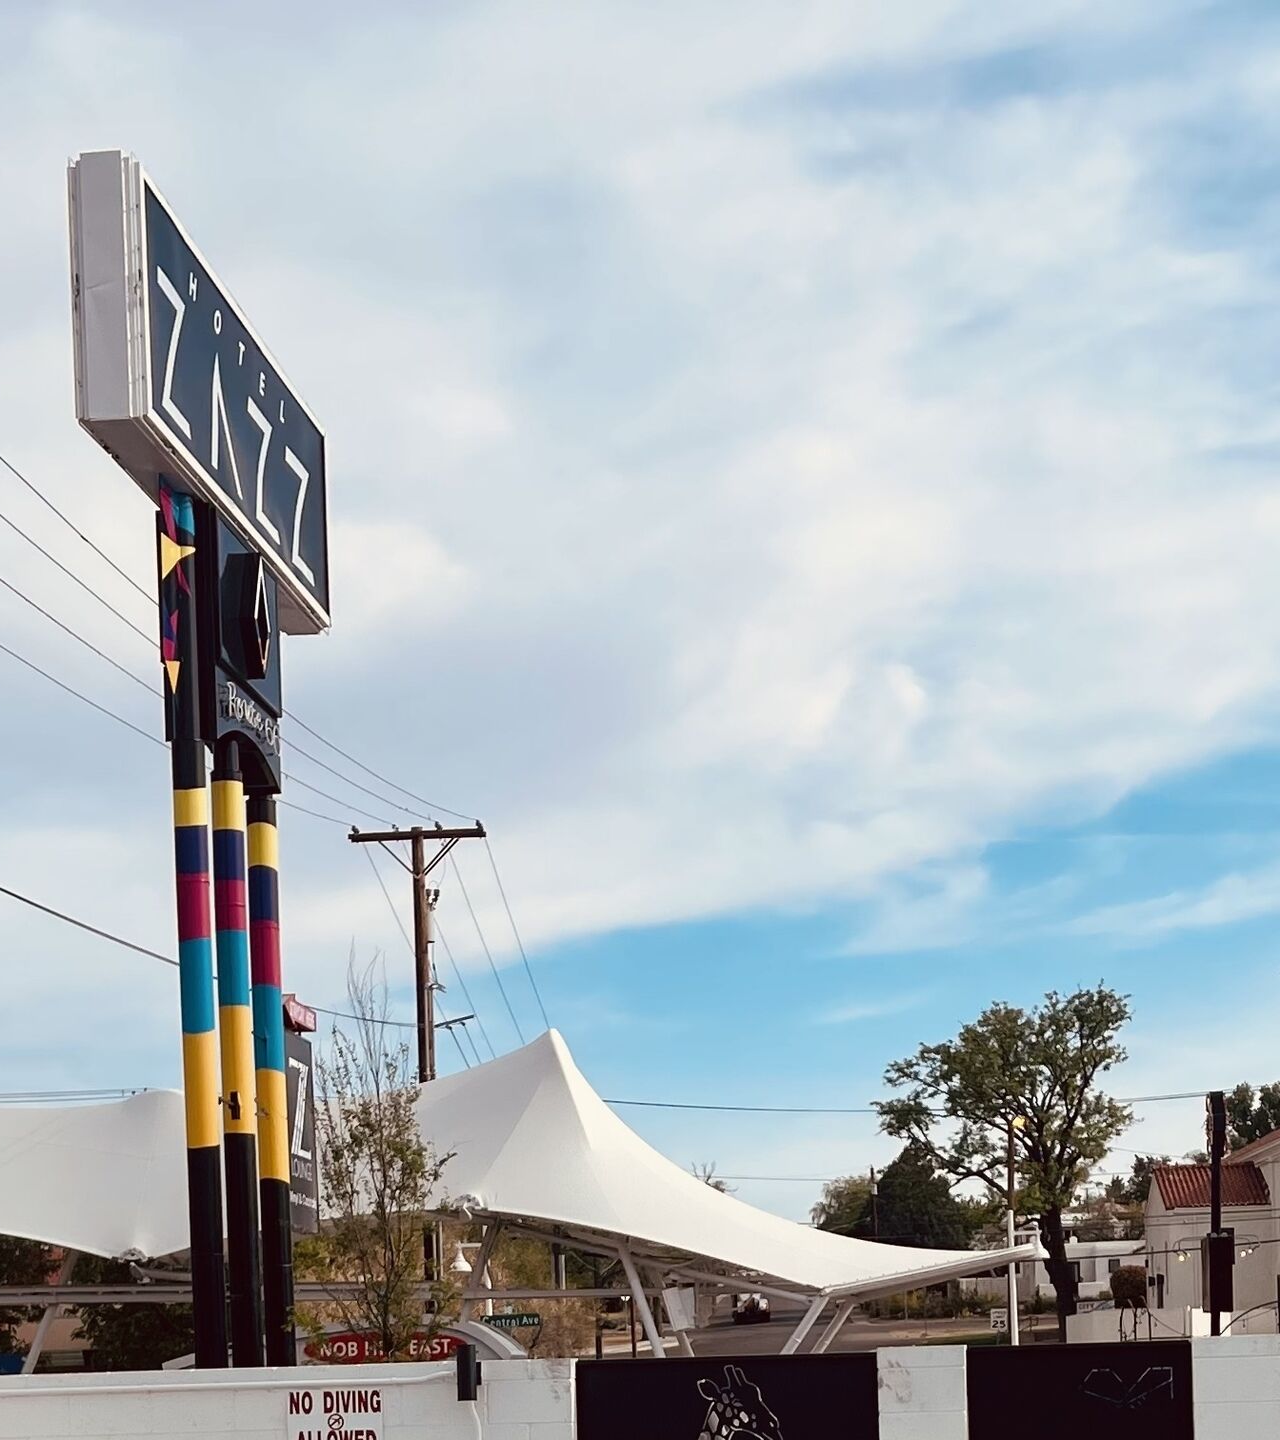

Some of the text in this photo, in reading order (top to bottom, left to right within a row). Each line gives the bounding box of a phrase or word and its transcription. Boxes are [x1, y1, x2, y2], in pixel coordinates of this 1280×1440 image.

[188, 271, 285, 424] HOTEL
[156, 265, 316, 587] ZAZZ
[227, 681, 281, 757] Route 66
[522, 1315, 539, 1325] Ave
[991, 1319, 1007, 1329] 25
[320, 1341, 359, 1357] NOB
[409, 1338, 451, 1355] EAST
[289, 1389, 382, 1414] NO DIVING
